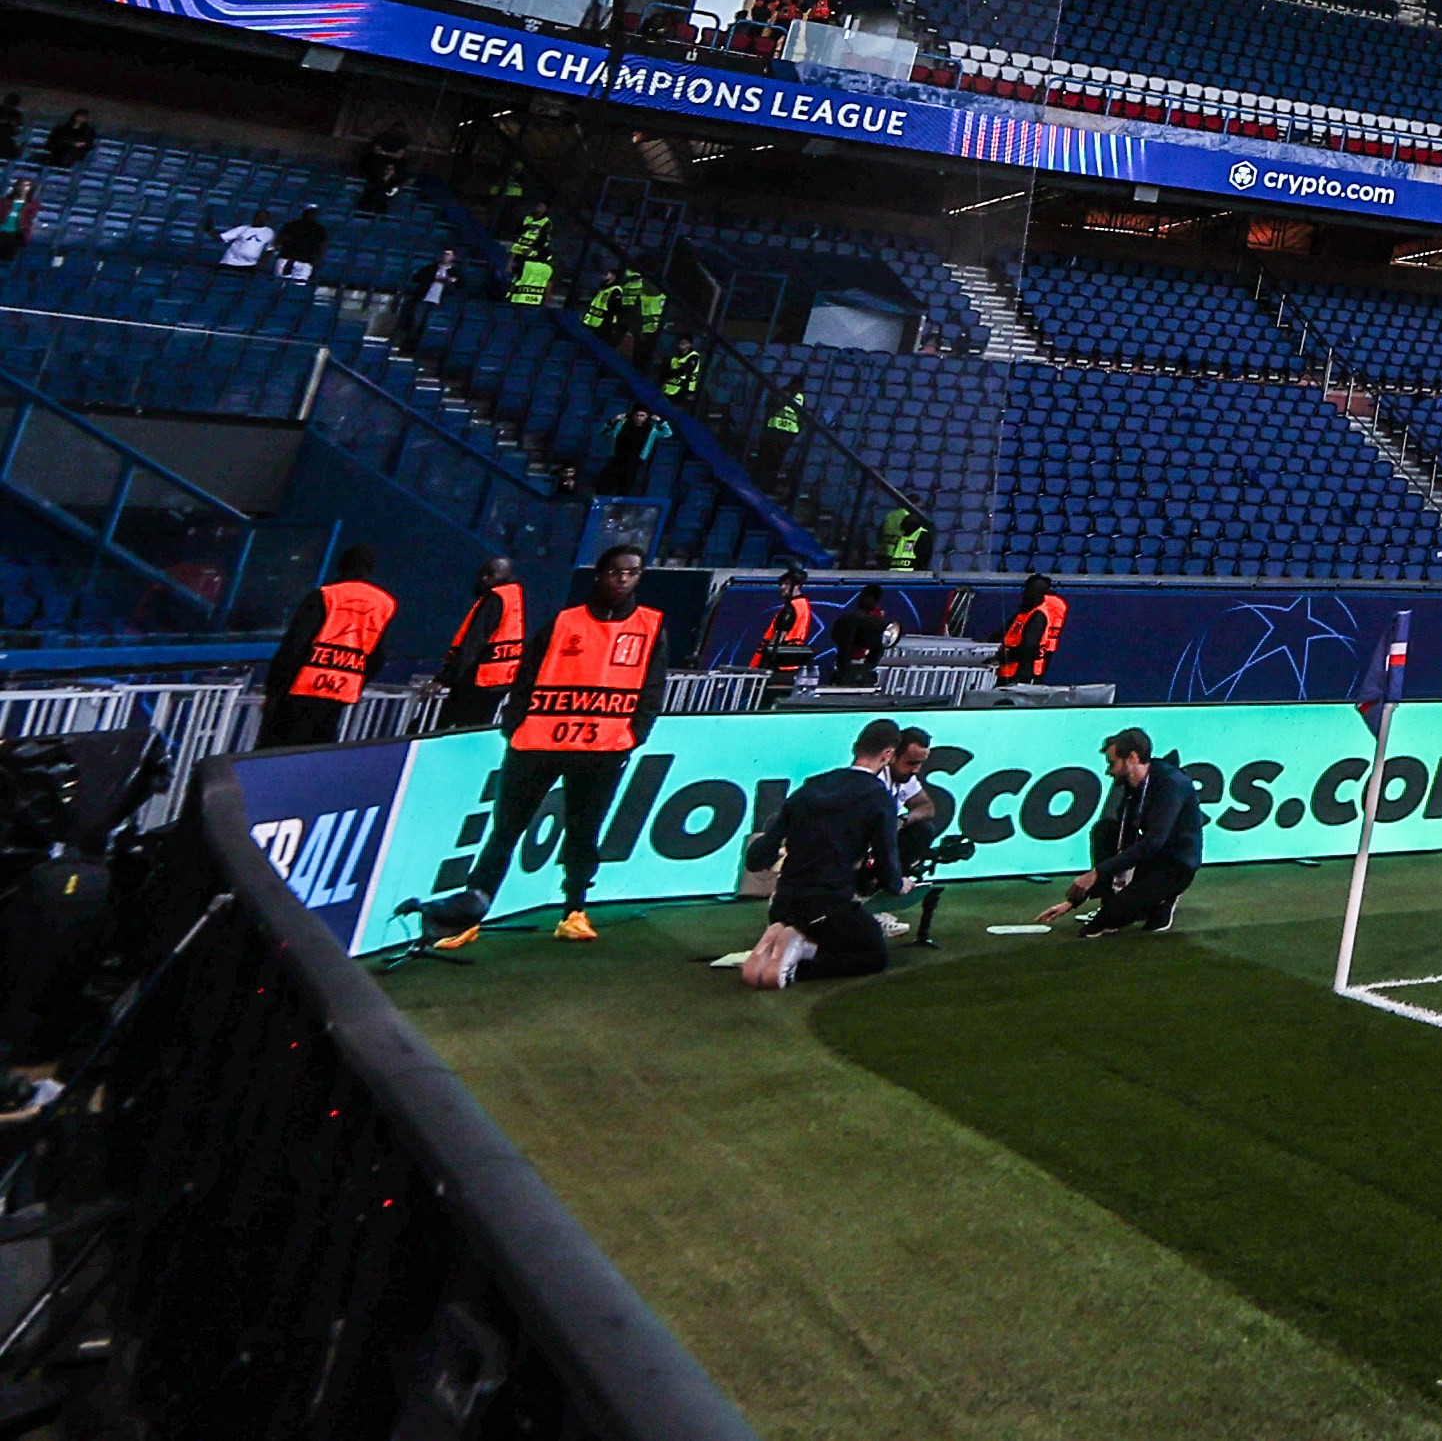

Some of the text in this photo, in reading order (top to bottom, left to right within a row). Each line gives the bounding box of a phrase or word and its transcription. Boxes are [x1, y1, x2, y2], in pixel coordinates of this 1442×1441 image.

[429, 25, 908, 136] UEFA CHAMPIONS LEAGUE
[1263, 170, 1395, 205] crypto.com
[313, 673, 348, 694] 042
[528, 690, 641, 714] STEWARD
[553, 721, 599, 744] 073
